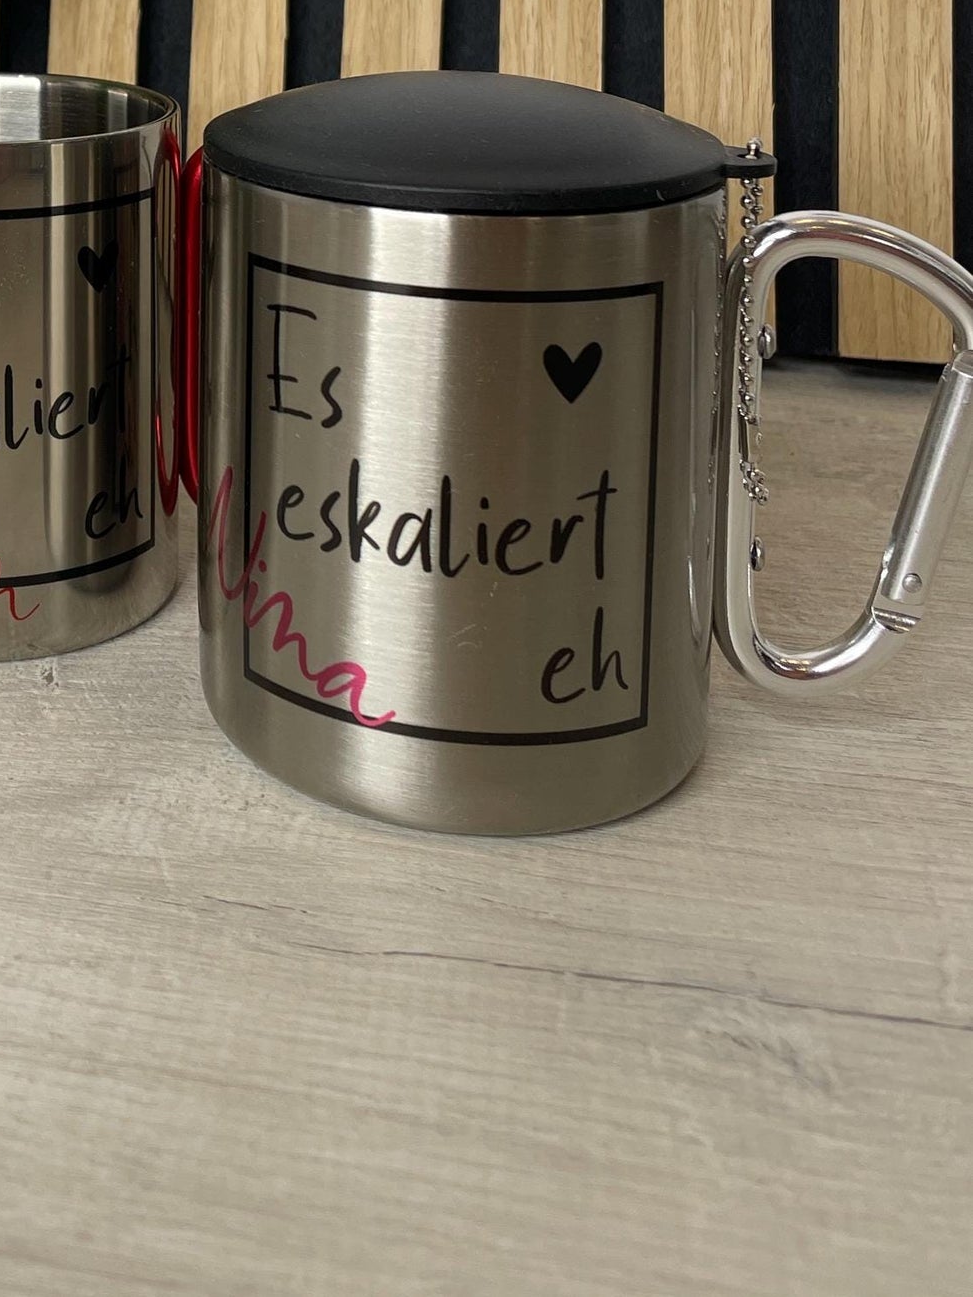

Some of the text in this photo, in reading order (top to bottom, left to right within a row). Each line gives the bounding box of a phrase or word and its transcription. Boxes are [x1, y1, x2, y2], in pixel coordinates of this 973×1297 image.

[267, 303, 343, 428] Es
[84, 454, 144, 540] eh
[276, 458, 618, 580] eskaliert
[206, 465, 396, 727] Nina
[540, 606, 630, 704] eh
